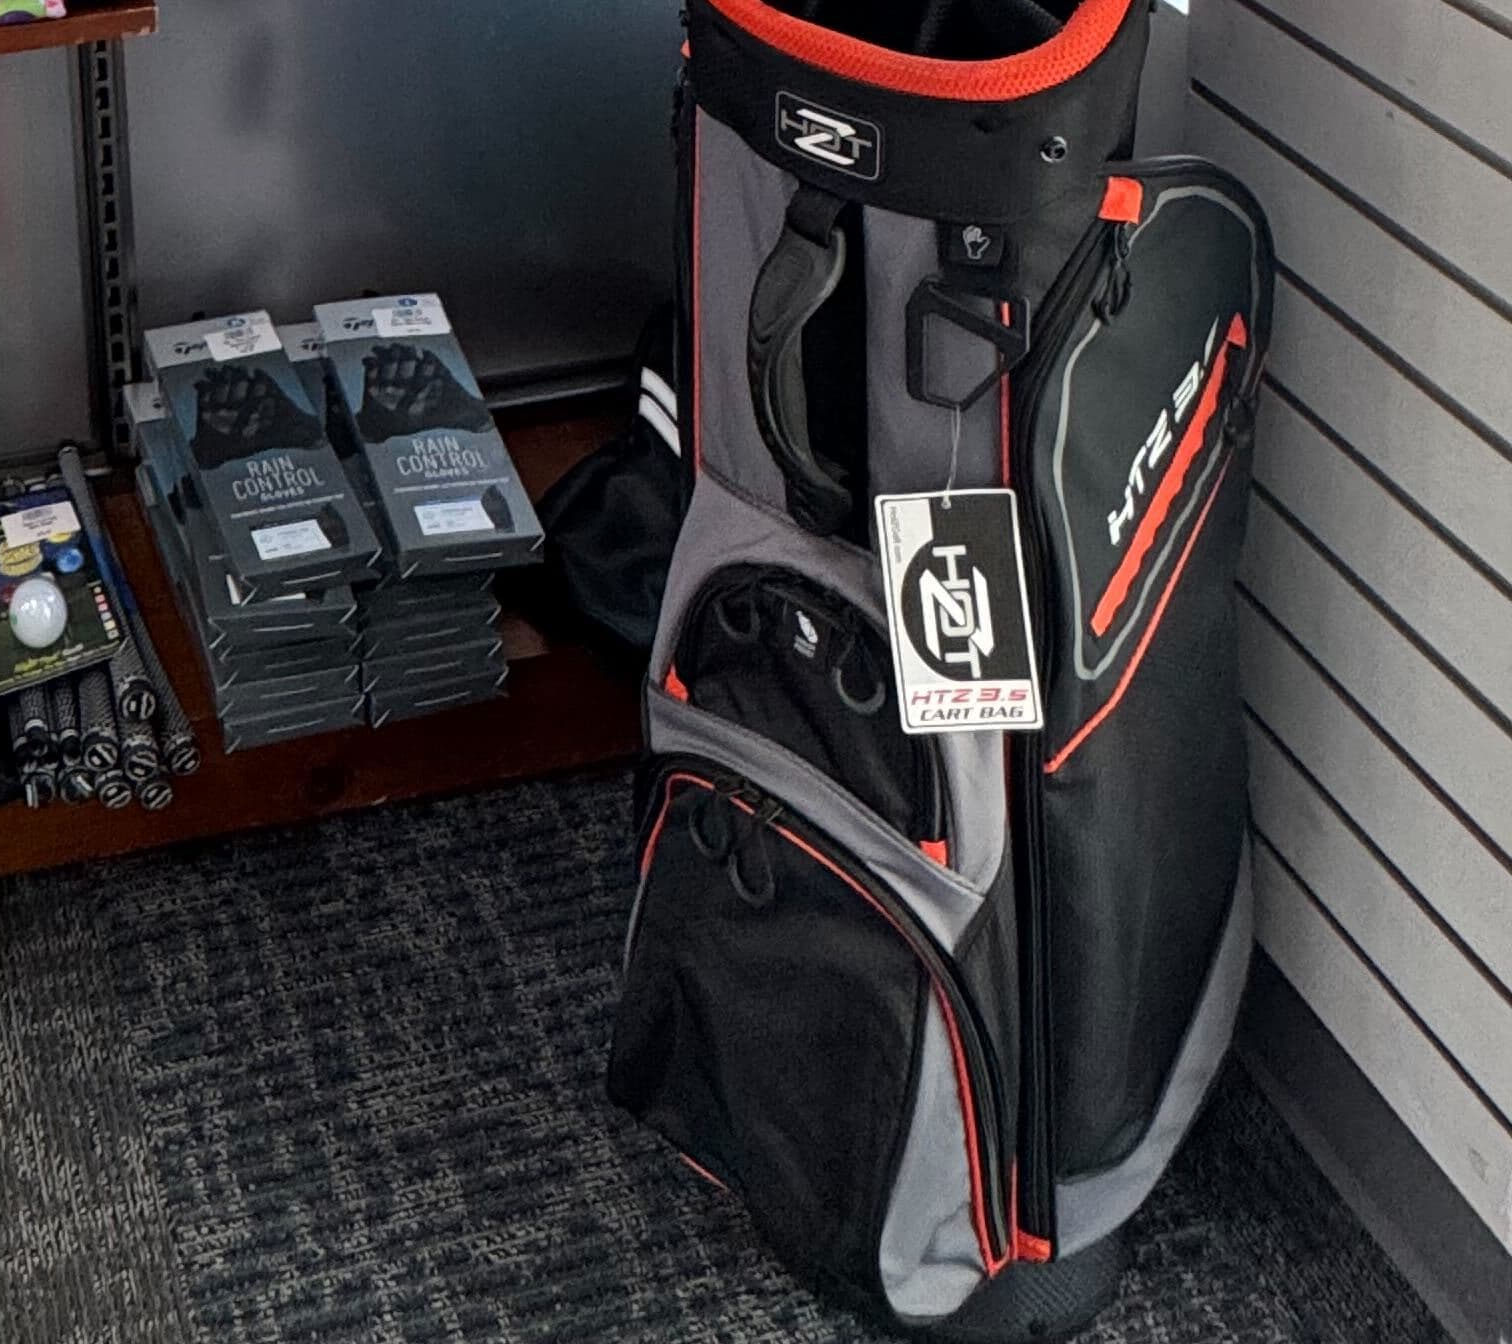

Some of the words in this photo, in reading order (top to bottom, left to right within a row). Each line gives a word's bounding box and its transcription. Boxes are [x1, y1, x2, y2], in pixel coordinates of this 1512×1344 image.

[412, 435, 460, 455] RAIN
[246, 455, 294, 478] RAIN
[396, 449, 488, 476] CONTROL
[232, 467, 326, 500] CONTROL
[1107, 409, 1173, 546] HTZ
[911, 688, 973, 706] HTZ
[977, 687, 1029, 702] 3.5
[920, 707, 974, 722] CART
[980, 706, 1024, 720] BAG
